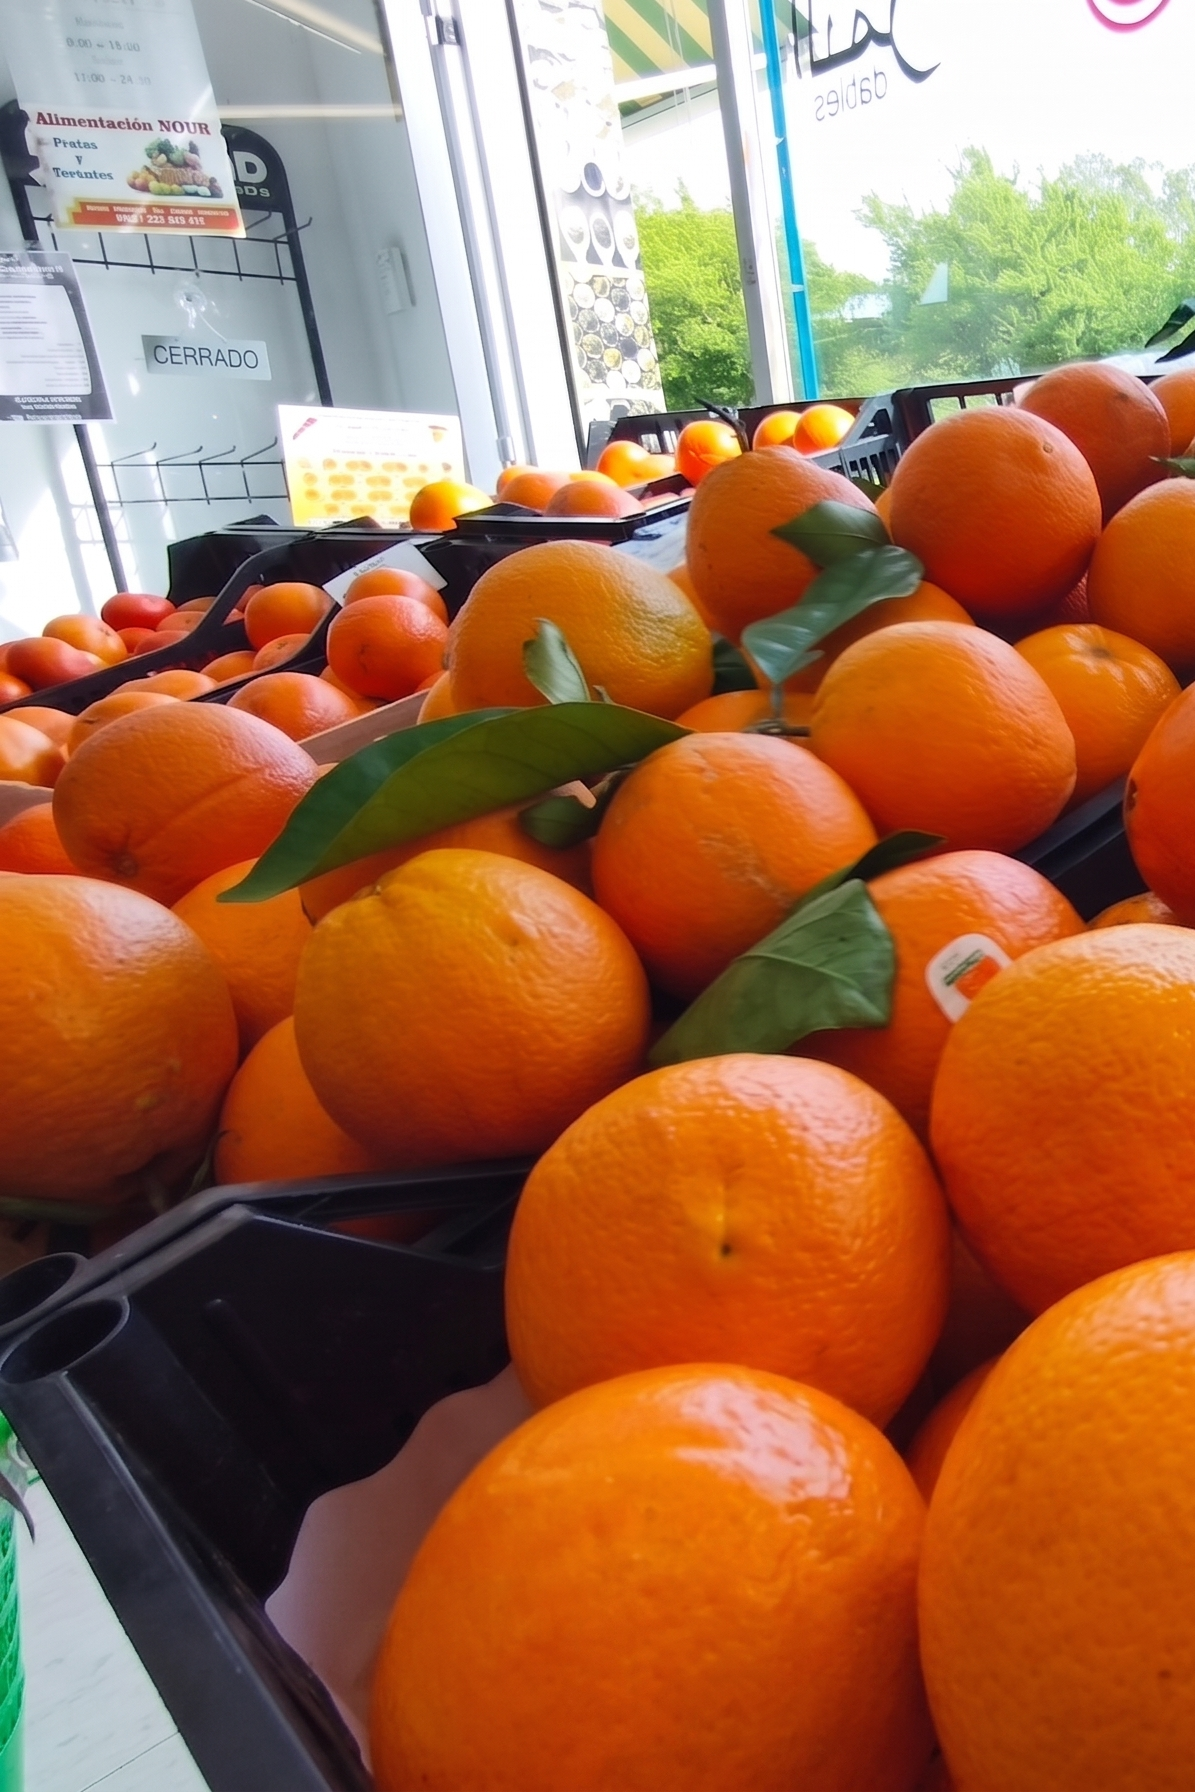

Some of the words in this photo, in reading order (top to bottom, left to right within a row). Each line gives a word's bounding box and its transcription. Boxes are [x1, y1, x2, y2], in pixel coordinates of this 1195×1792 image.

[36, 112, 153, 132] Alimentación
[158, 120, 211, 135] NOUR
[231, 151, 267, 183] D
[153, 345, 259, 369] CERRADO
